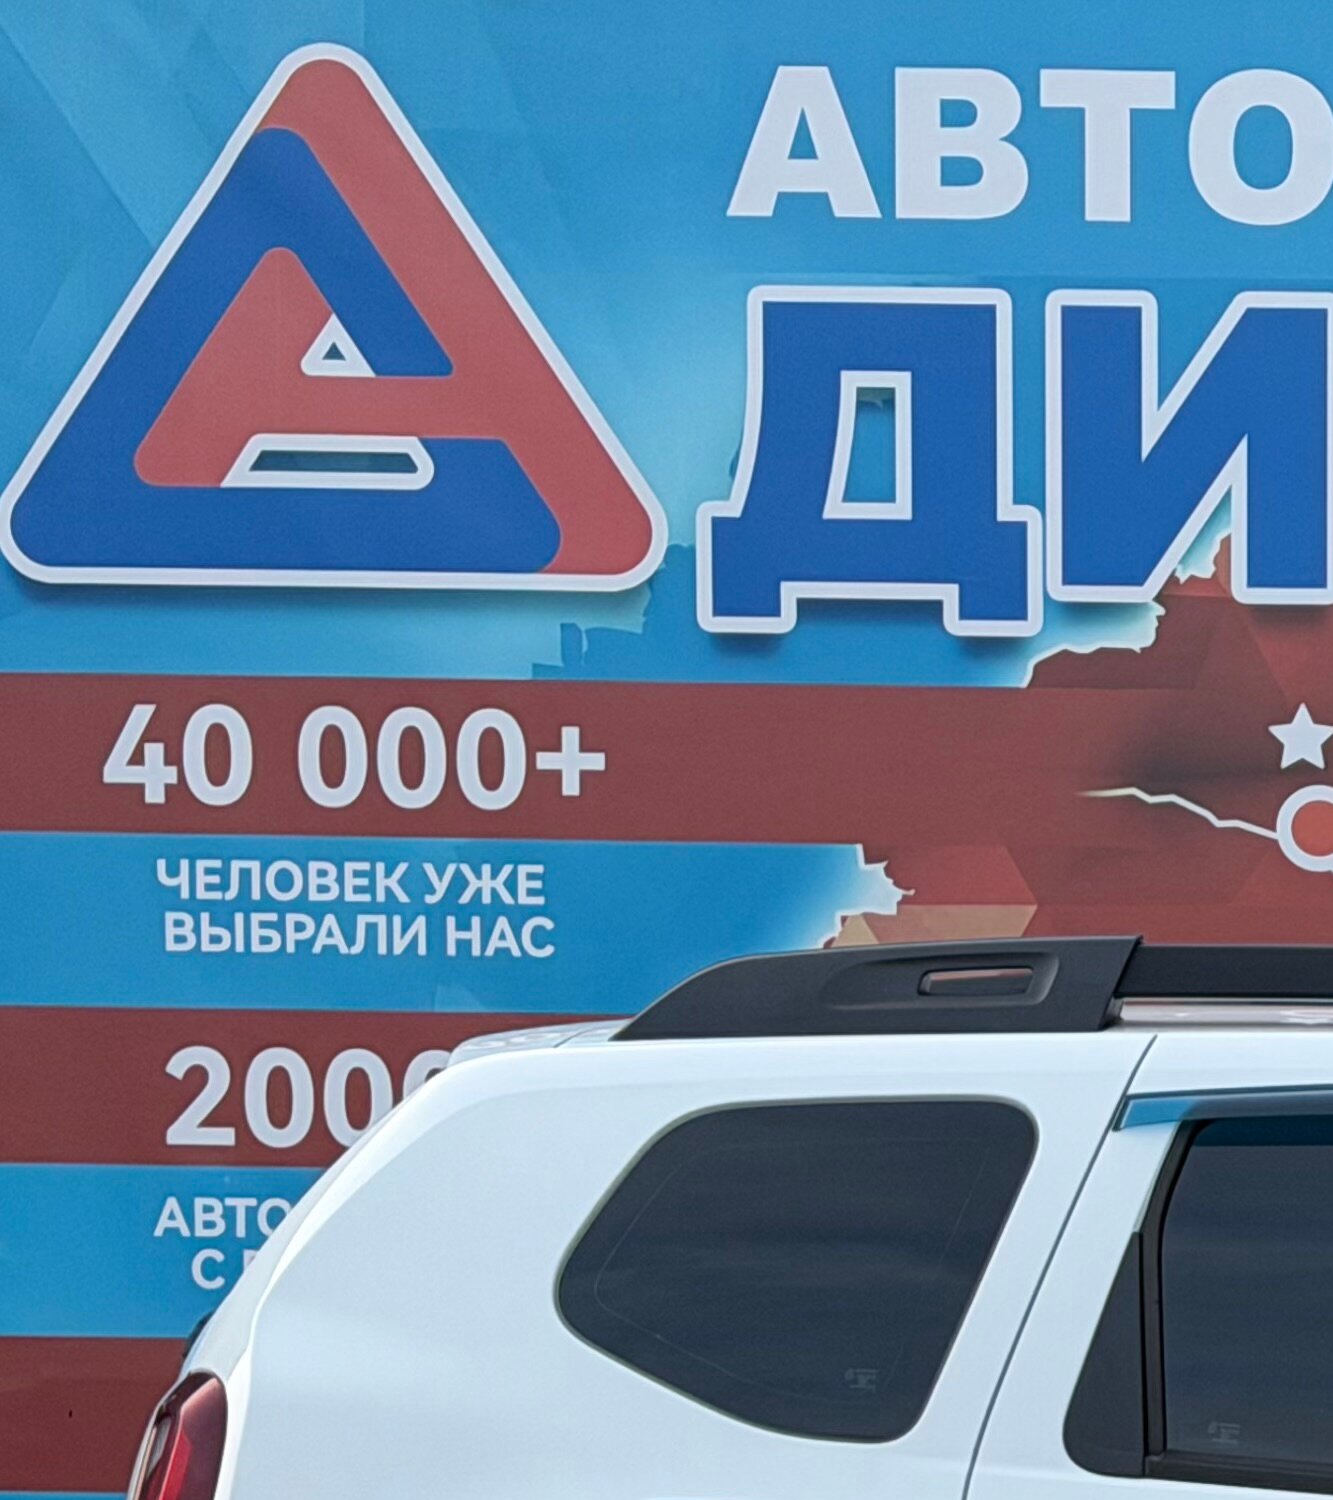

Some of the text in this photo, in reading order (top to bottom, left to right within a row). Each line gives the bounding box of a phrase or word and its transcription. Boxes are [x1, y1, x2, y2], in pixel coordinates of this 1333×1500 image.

[102, 703, 606, 811] 40 000+
[155, 858, 545, 905] ЧЕЛОВЕК УЖЕ
[163, 911, 556, 958] ВЫБРАЛИ НАС
[191, 1248, 226, 1290] С
